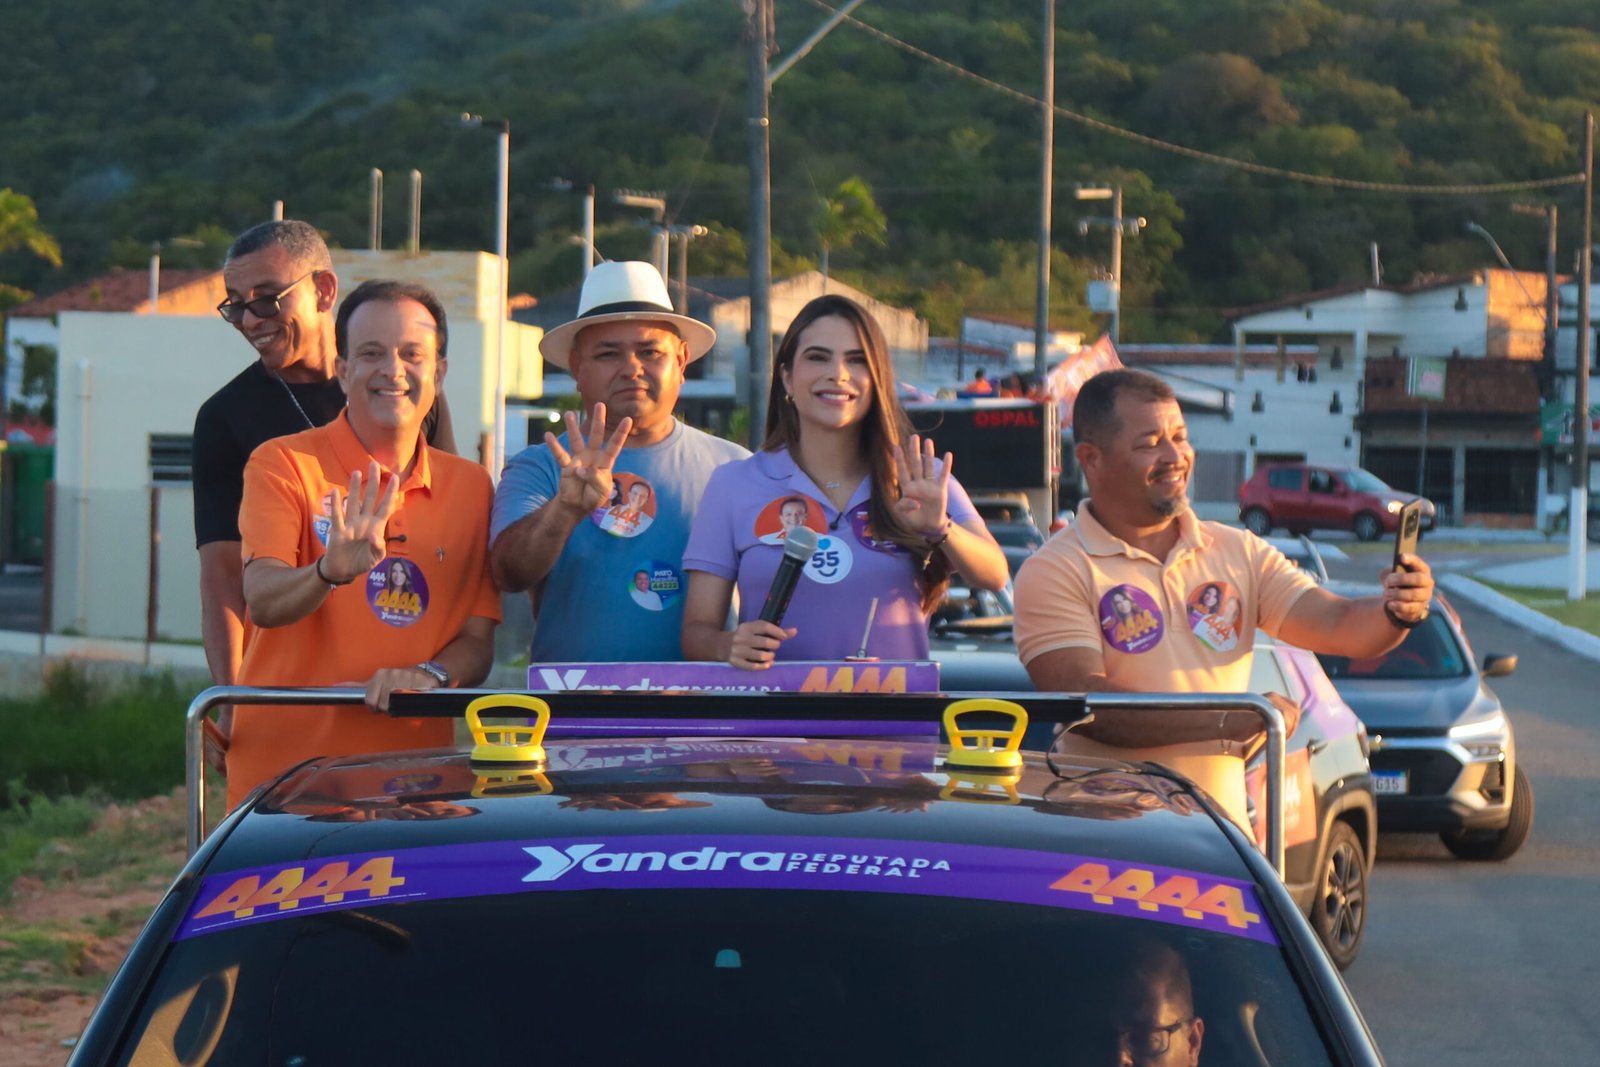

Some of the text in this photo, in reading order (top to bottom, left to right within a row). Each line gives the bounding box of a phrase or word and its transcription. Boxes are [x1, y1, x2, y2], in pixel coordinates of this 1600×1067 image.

[812, 551, 840, 568] 55
[374, 588, 422, 616] 4444
[1115, 609, 1158, 643] 4444
[786, 861, 921, 878] FEDERAL
[193, 856, 406, 920] 4444
[521, 843, 787, 882] Yandra
[790, 852, 951, 871] DEPUTADA
[1049, 862, 1261, 929] 4444
